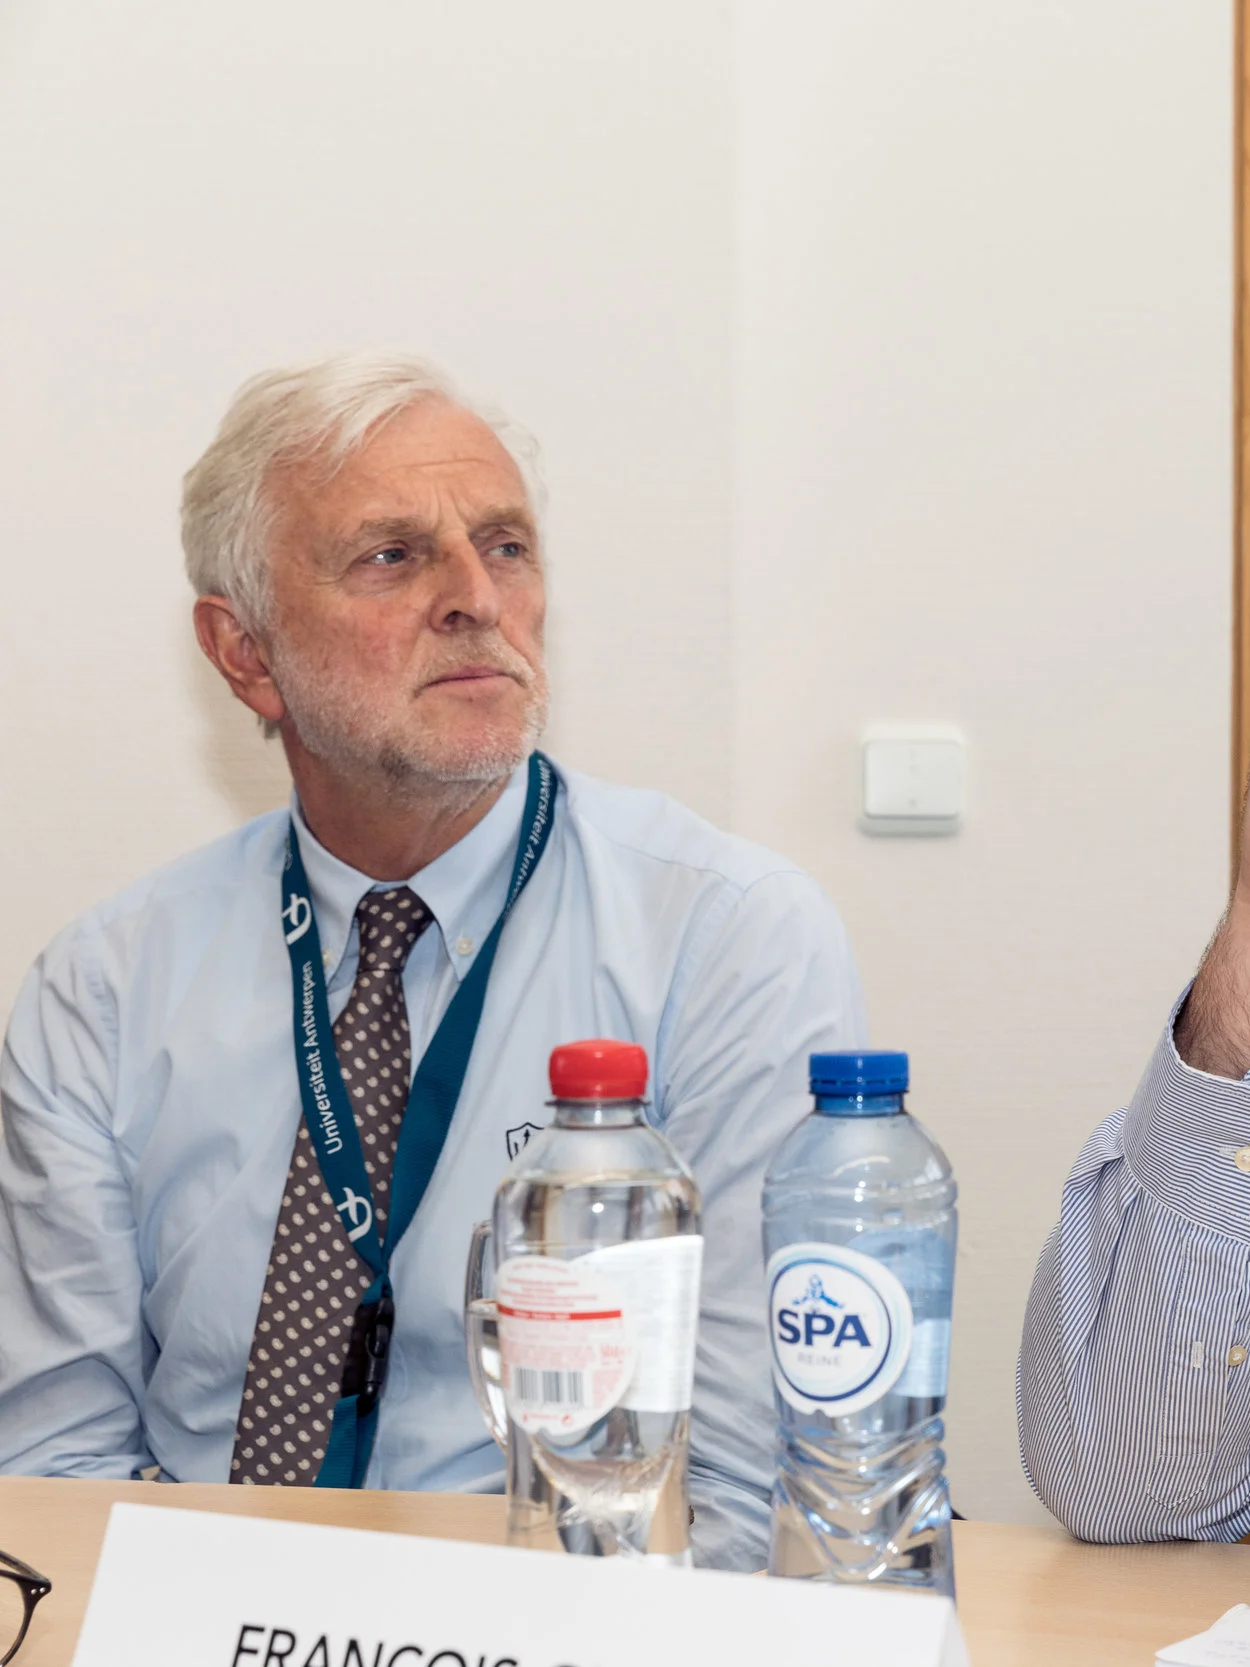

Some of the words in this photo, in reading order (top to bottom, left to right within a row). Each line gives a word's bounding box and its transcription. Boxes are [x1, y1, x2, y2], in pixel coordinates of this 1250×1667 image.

[528, 759, 552, 845] Universiteit
[302, 960, 319, 1048] Antwerpen
[305, 1048, 343, 1155] Universiteit
[778, 1308, 872, 1347] SPA
